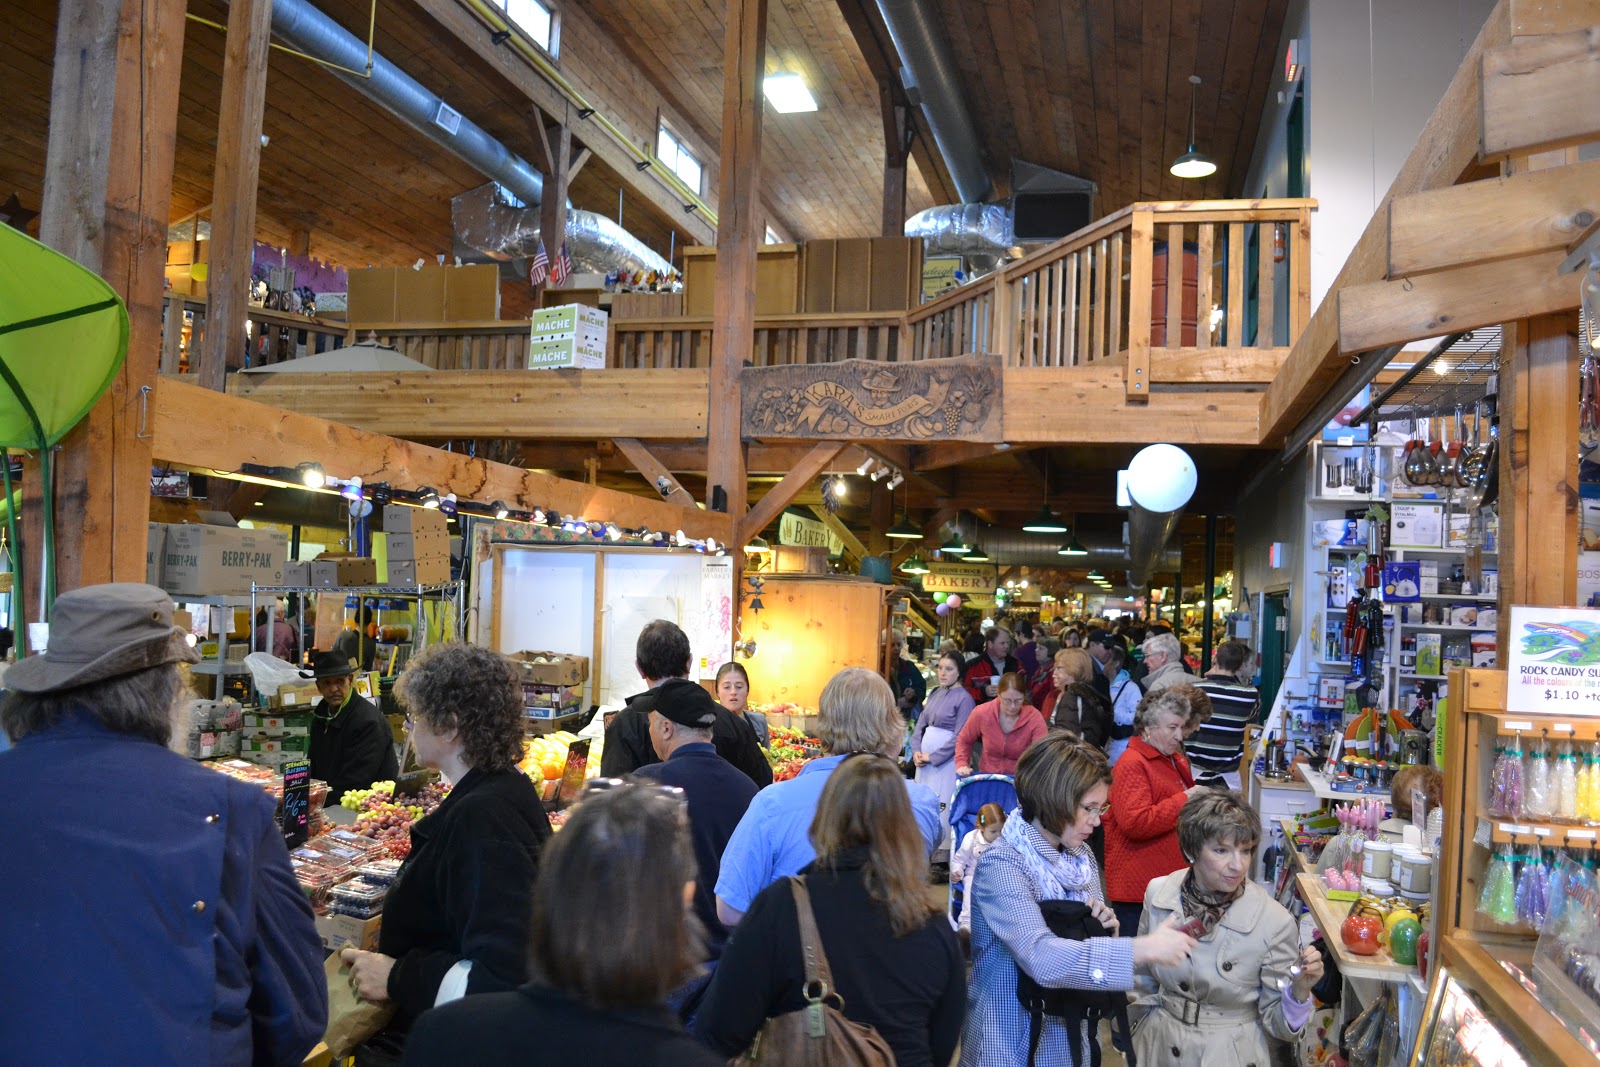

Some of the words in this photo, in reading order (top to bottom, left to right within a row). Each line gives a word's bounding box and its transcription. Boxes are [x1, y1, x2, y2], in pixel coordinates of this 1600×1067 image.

[806, 382, 865, 418] KARA'S
[865, 412, 895, 422] SMART
[898, 398, 919, 416] FOODS
[794, 521, 832, 548] BAKERY
[166, 553, 198, 568] BERRY-PAK
[221, 550, 272, 569] BERRY-PAK
[926, 574, 994, 588] BAKERY
[1520, 666, 1549, 675] ROCK
[1551, 666, 1586, 677] CANDY
[1521, 675, 1532, 685] All
[1533, 676, 1545, 686] the
[1584, 678, 1596, 687] the
[1544, 689, 1579, 701] $1.10
[290, 778, 303, 786] SALE
